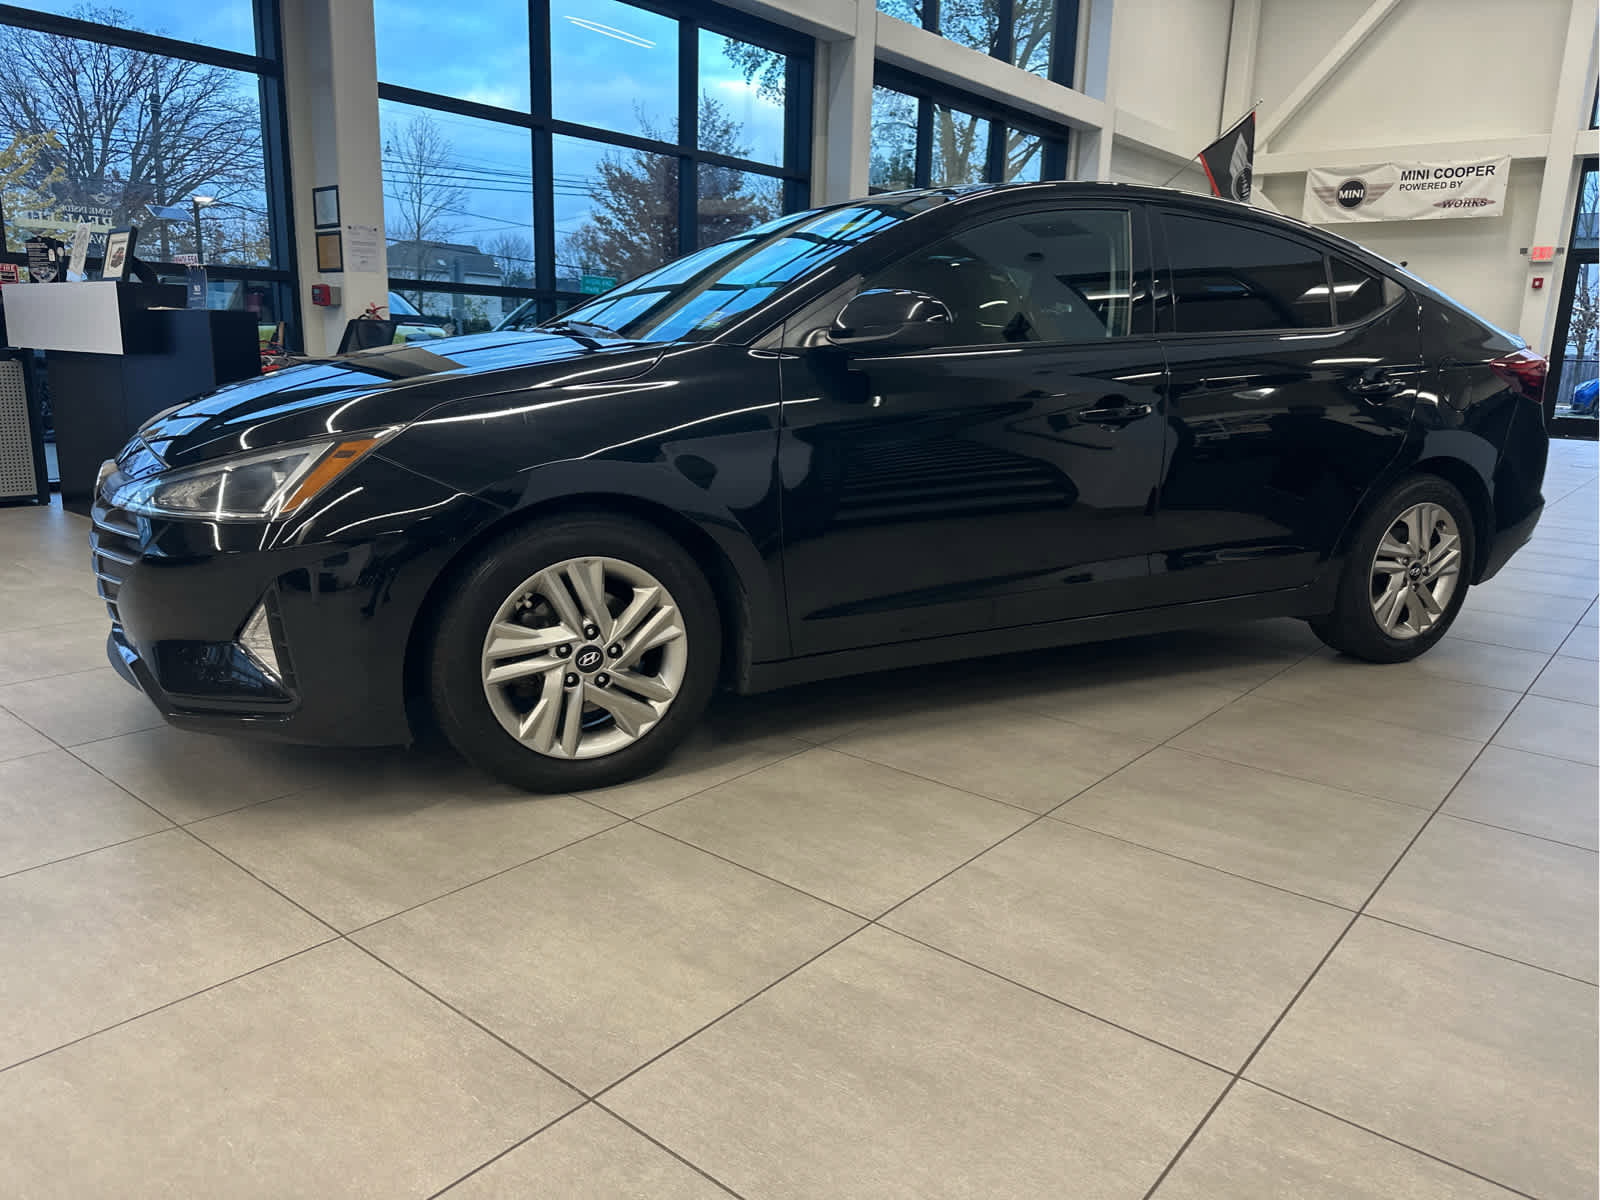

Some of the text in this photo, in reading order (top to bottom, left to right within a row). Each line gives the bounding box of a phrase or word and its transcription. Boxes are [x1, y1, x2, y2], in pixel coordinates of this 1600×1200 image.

[1400, 165, 1496, 181] MINI COOPER
[1399, 180, 1463, 191] POWERED BY
[1338, 189, 1364, 199] MINI
[1442, 198, 1488, 209] WORKS
[1532, 246, 1552, 260] EXIT
